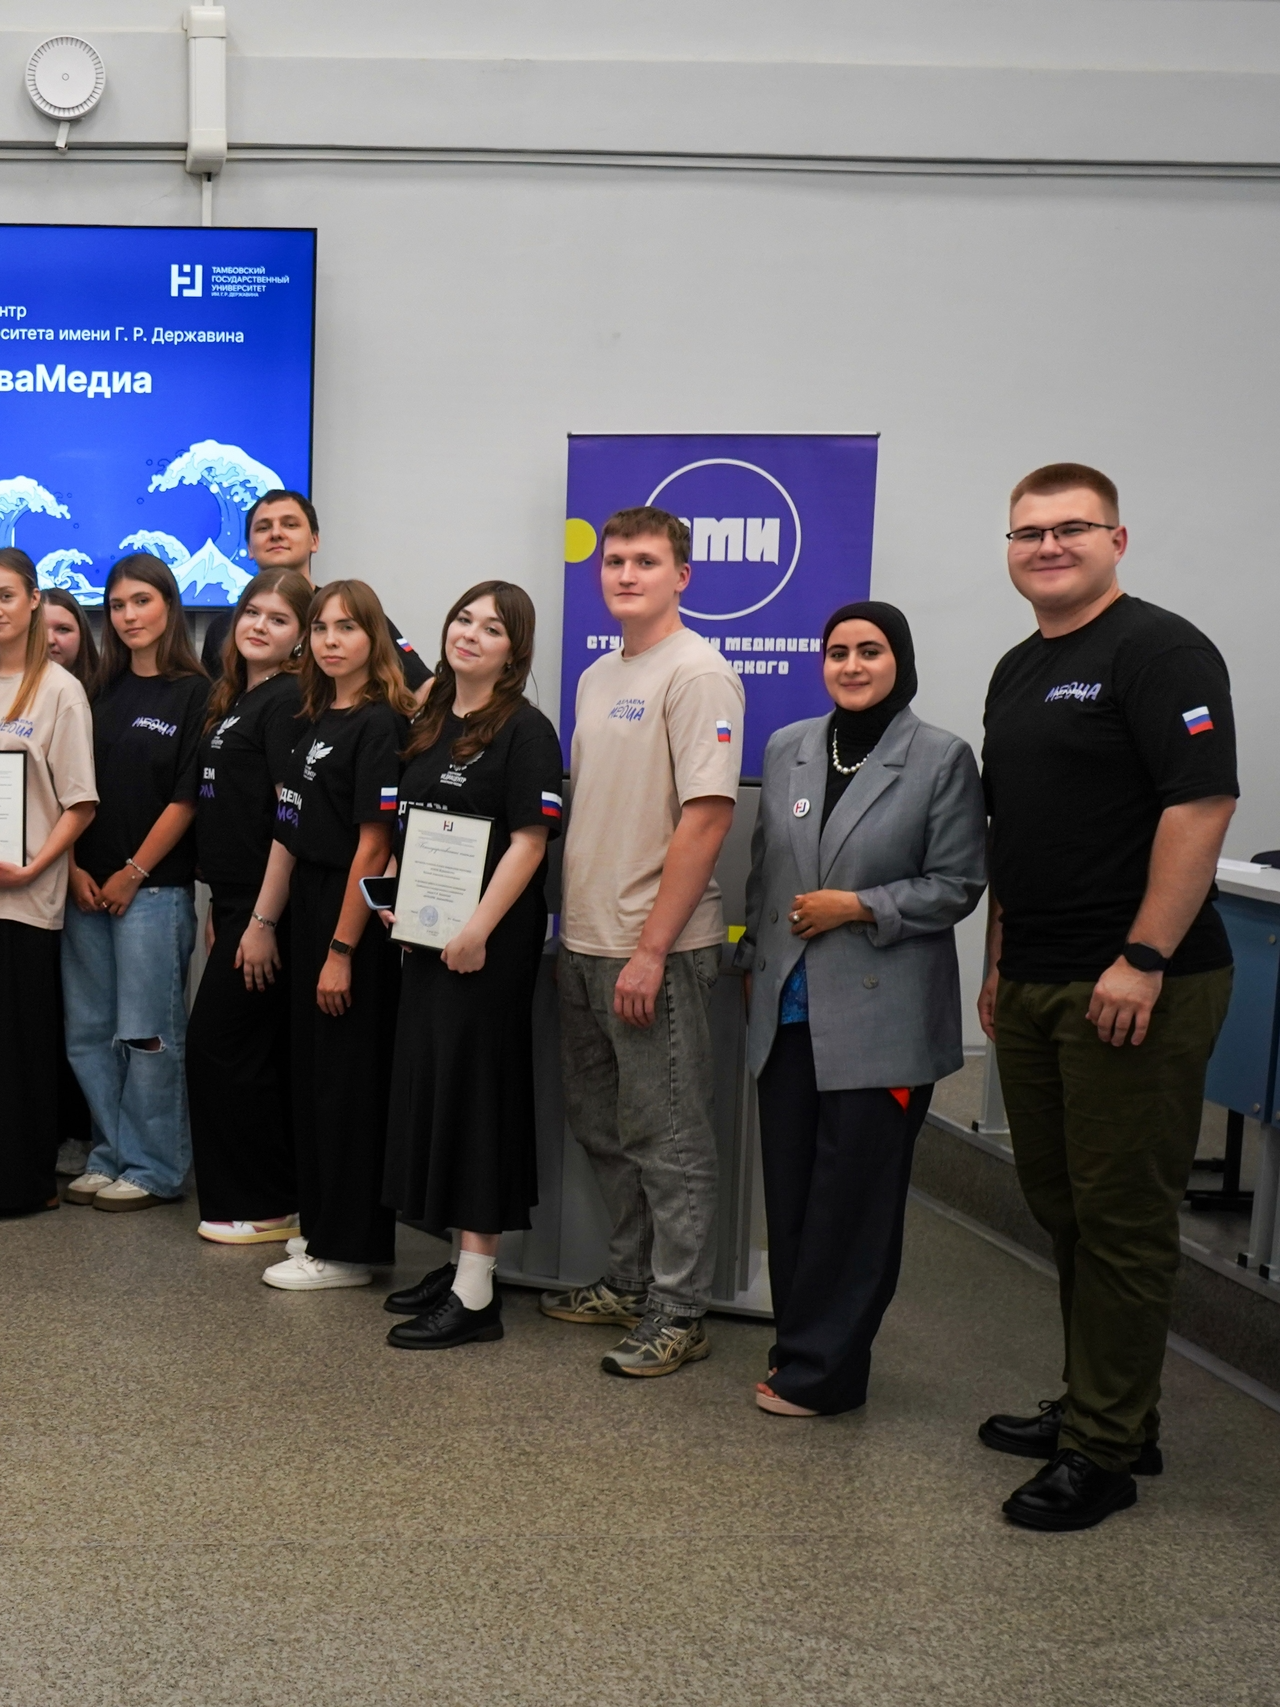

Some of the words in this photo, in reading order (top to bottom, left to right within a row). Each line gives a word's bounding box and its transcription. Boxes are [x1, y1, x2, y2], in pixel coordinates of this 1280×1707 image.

[211, 266, 266, 274] ТАМБОВСКИЙ
[211, 275, 290, 284] ГОСУДАРСТВЕННЫЙ
[211, 284, 267, 292] УНИВЕРСИТЕТ
[59, 329, 111, 342] имени
[115, 327, 128, 342] Г.
[133, 327, 147, 342] Р.
[151, 327, 245, 346] Державина
[678, 517, 780, 566] МИ
[725, 636, 823, 652] МЕДИАЦЕН
